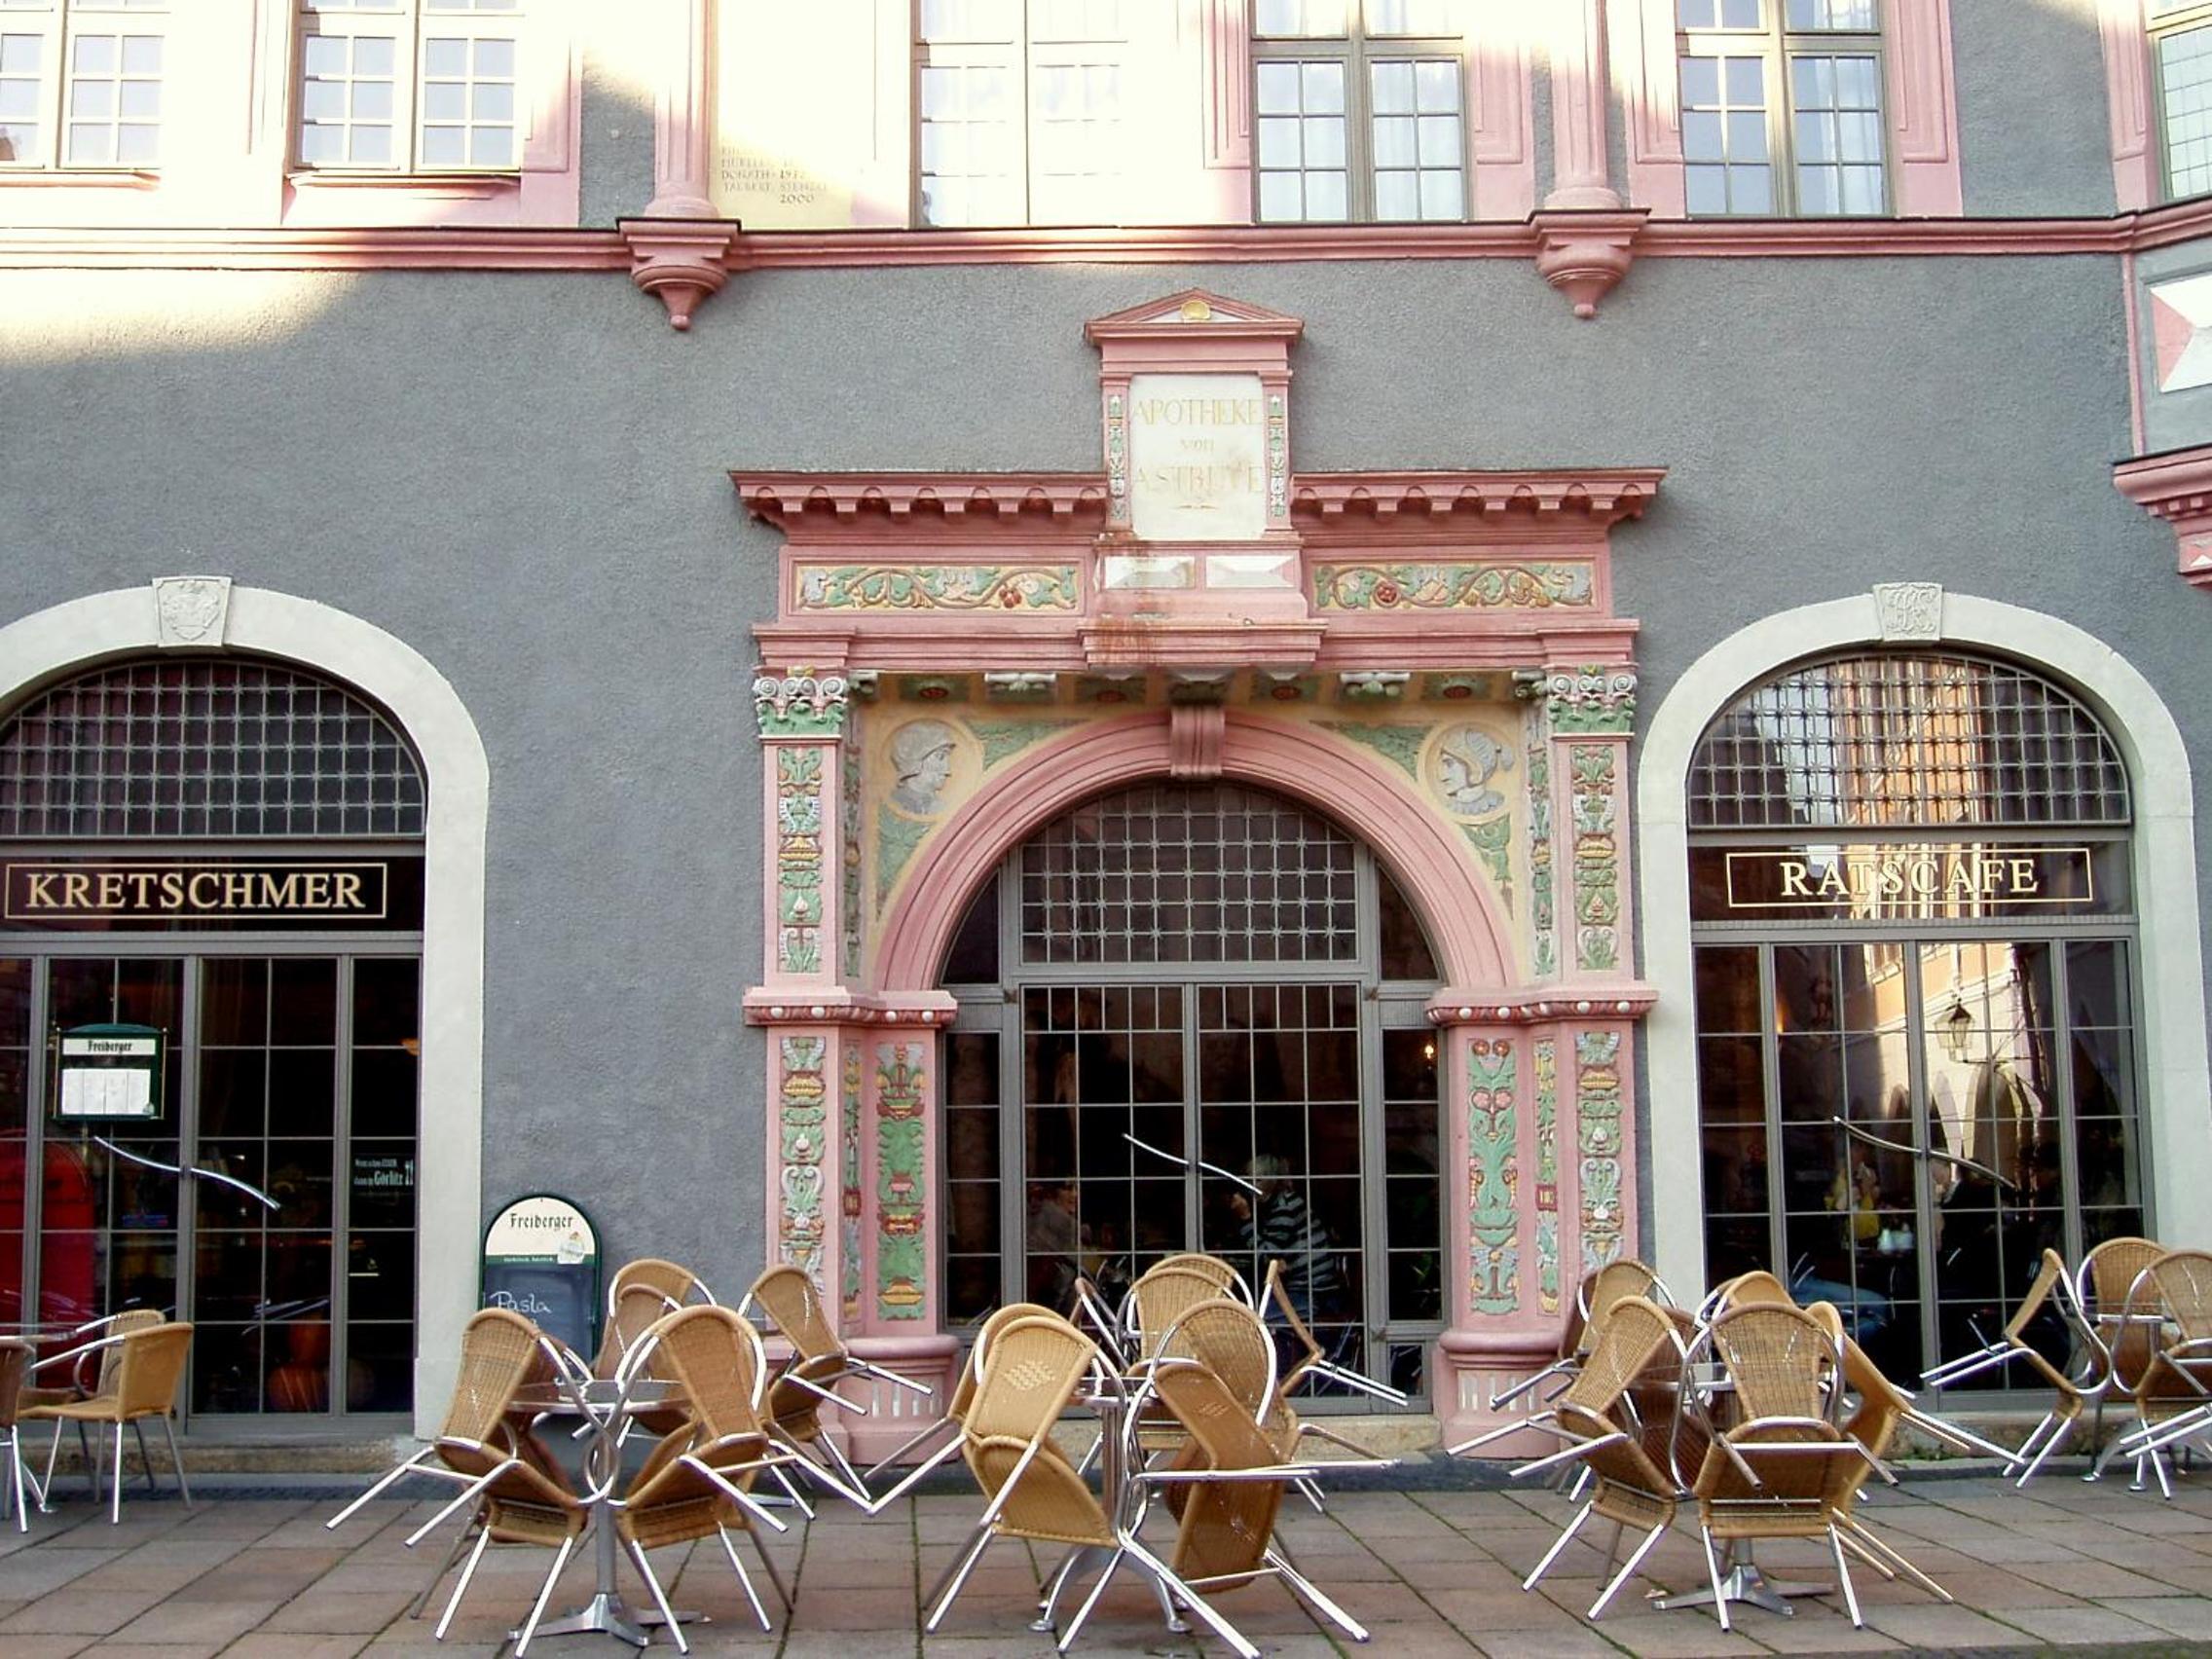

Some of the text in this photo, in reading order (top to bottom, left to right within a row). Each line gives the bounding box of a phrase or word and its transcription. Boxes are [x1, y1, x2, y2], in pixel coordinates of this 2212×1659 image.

[1133, 398, 1263, 425] APOTHEKE
[25, 871, 367, 909] KRETSCHMER
[1780, 858, 2040, 897] RATSCAFE
[88, 1040, 133, 1054] Freiberger
[509, 1212, 573, 1232] Freiberger
